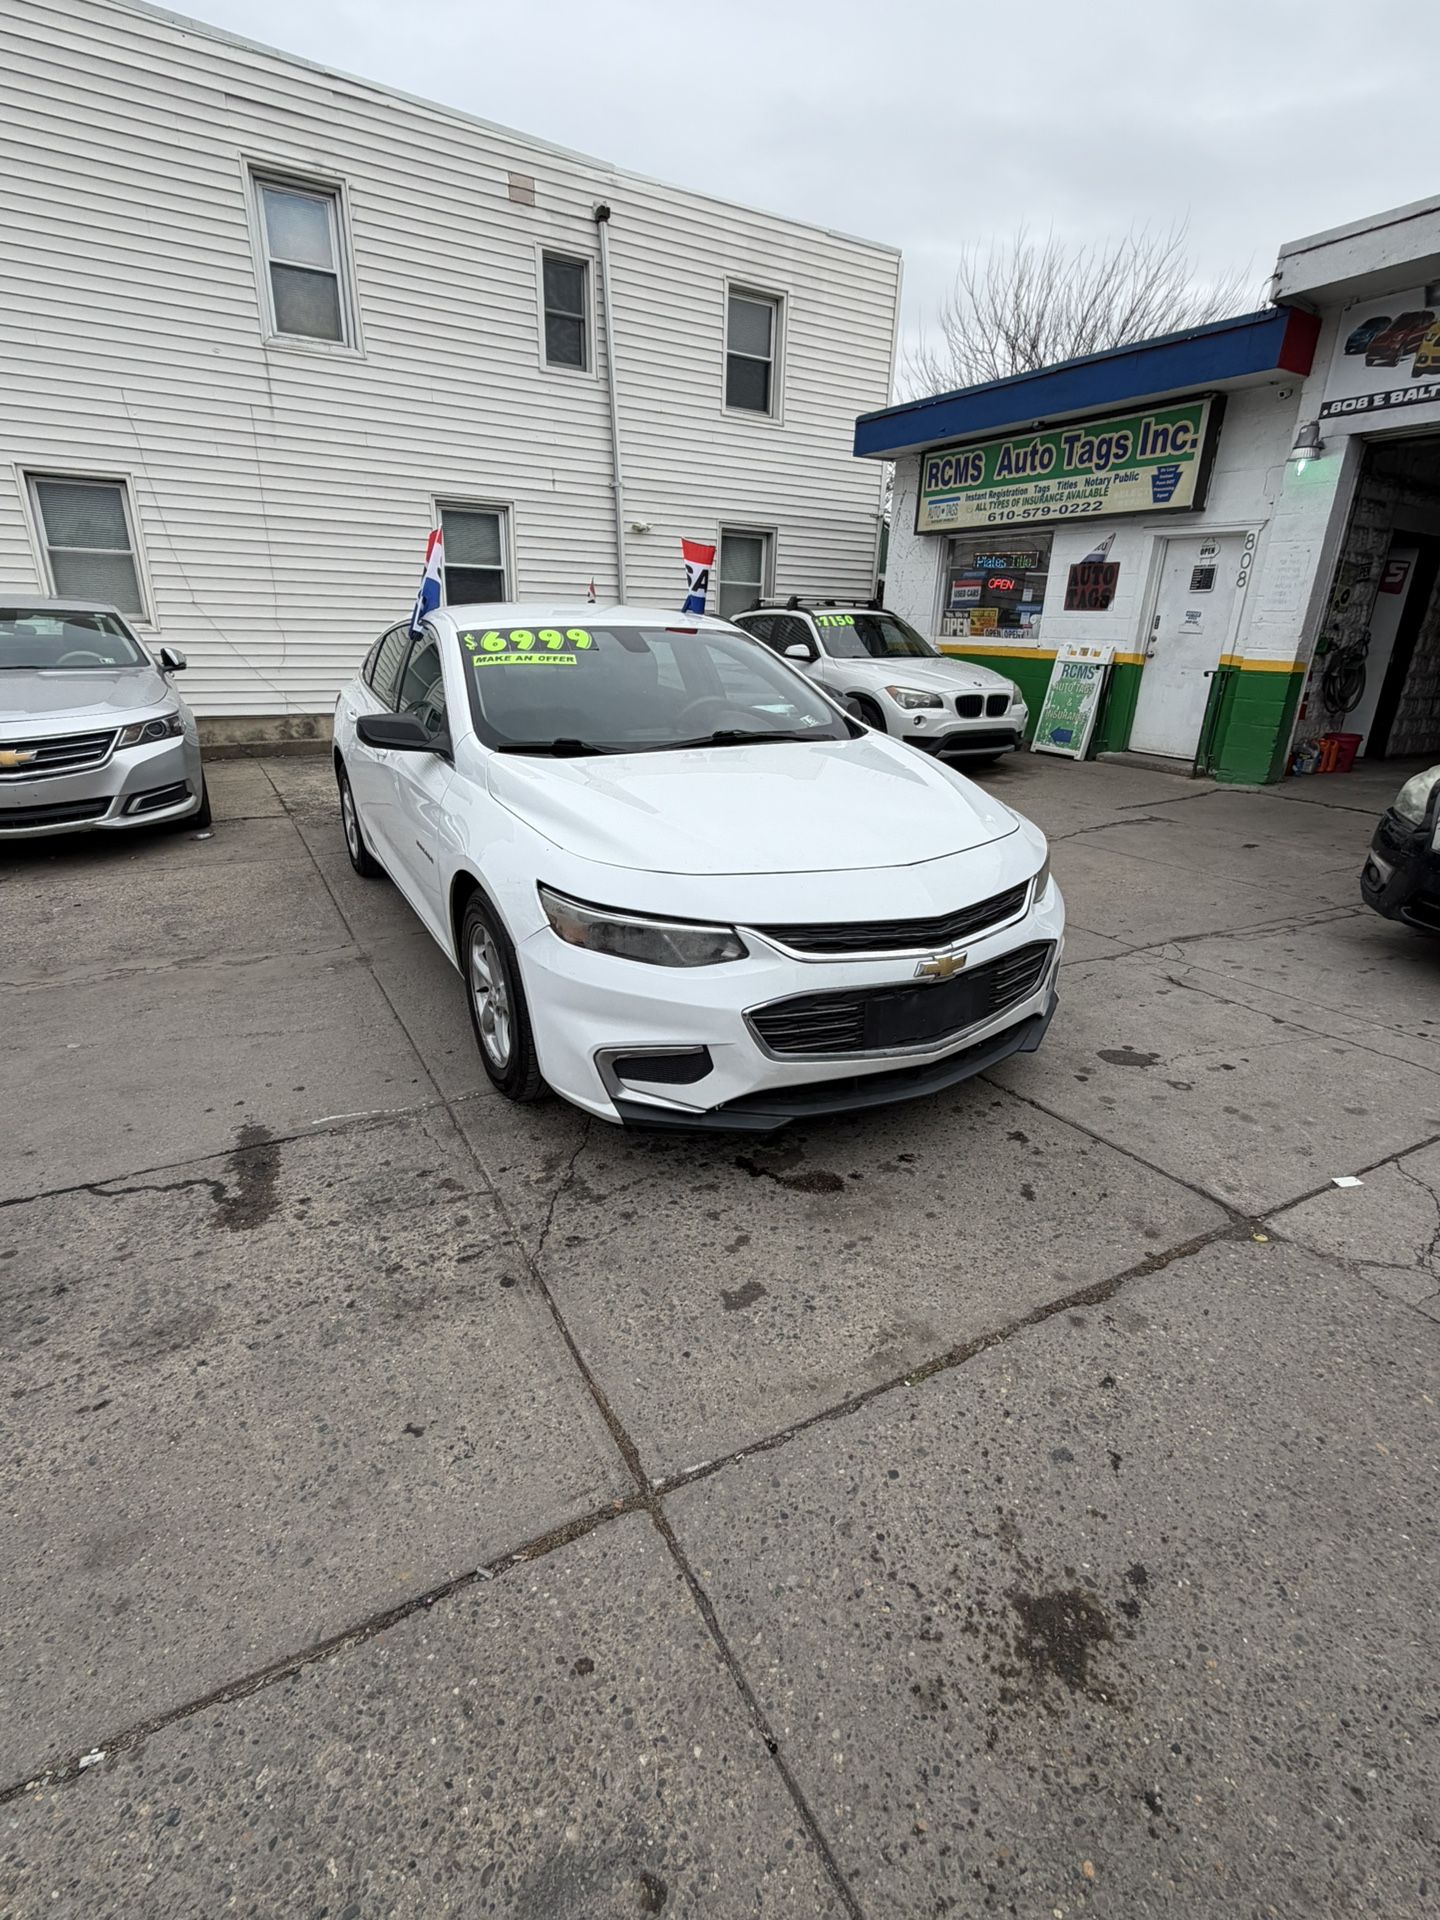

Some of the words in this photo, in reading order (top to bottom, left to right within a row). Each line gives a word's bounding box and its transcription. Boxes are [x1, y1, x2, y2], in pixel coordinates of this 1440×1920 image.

[1373, 393, 1386, 406] E
[926, 452, 984, 490] RCMS
[995, 440, 1055, 479] Auto
[1062, 431, 1131, 471] Tags
[1138, 420, 1199, 457] Inc.
[965, 492, 987, 501] Instant
[988, 487, 1028, 499] Registration
[1033, 484, 1050, 496] Tags
[1057, 480, 1078, 491] Titles
[1084, 475, 1111, 488] Notary
[1113, 471, 1139, 485] Public
[975, 502, 986, 512] ALL
[989, 500, 1009, 510] TYPES
[1011, 499, 1020, 508] OF
[1021, 492, 1064, 507] INSURANCE
[1065, 487, 1109, 501] AVAILABLE
[987, 501, 1103, 522] 610-579-0222
[1200, 546, 1216, 556] OPEN
[988, 578, 1015, 590] OPEN
[1070, 565, 1115, 586] AUTO
[954, 589, 966, 598] USED
[966, 589, 979, 597] CARS
[1067, 588, 1113, 609] TAGS
[943, 618, 970, 636] OPEN
[463, 628, 592, 652] $6999
[476, 655, 512, 663] MAKE
[1061, 663, 1096, 680] RCMS
[1053, 682, 1074, 693] AUTO
